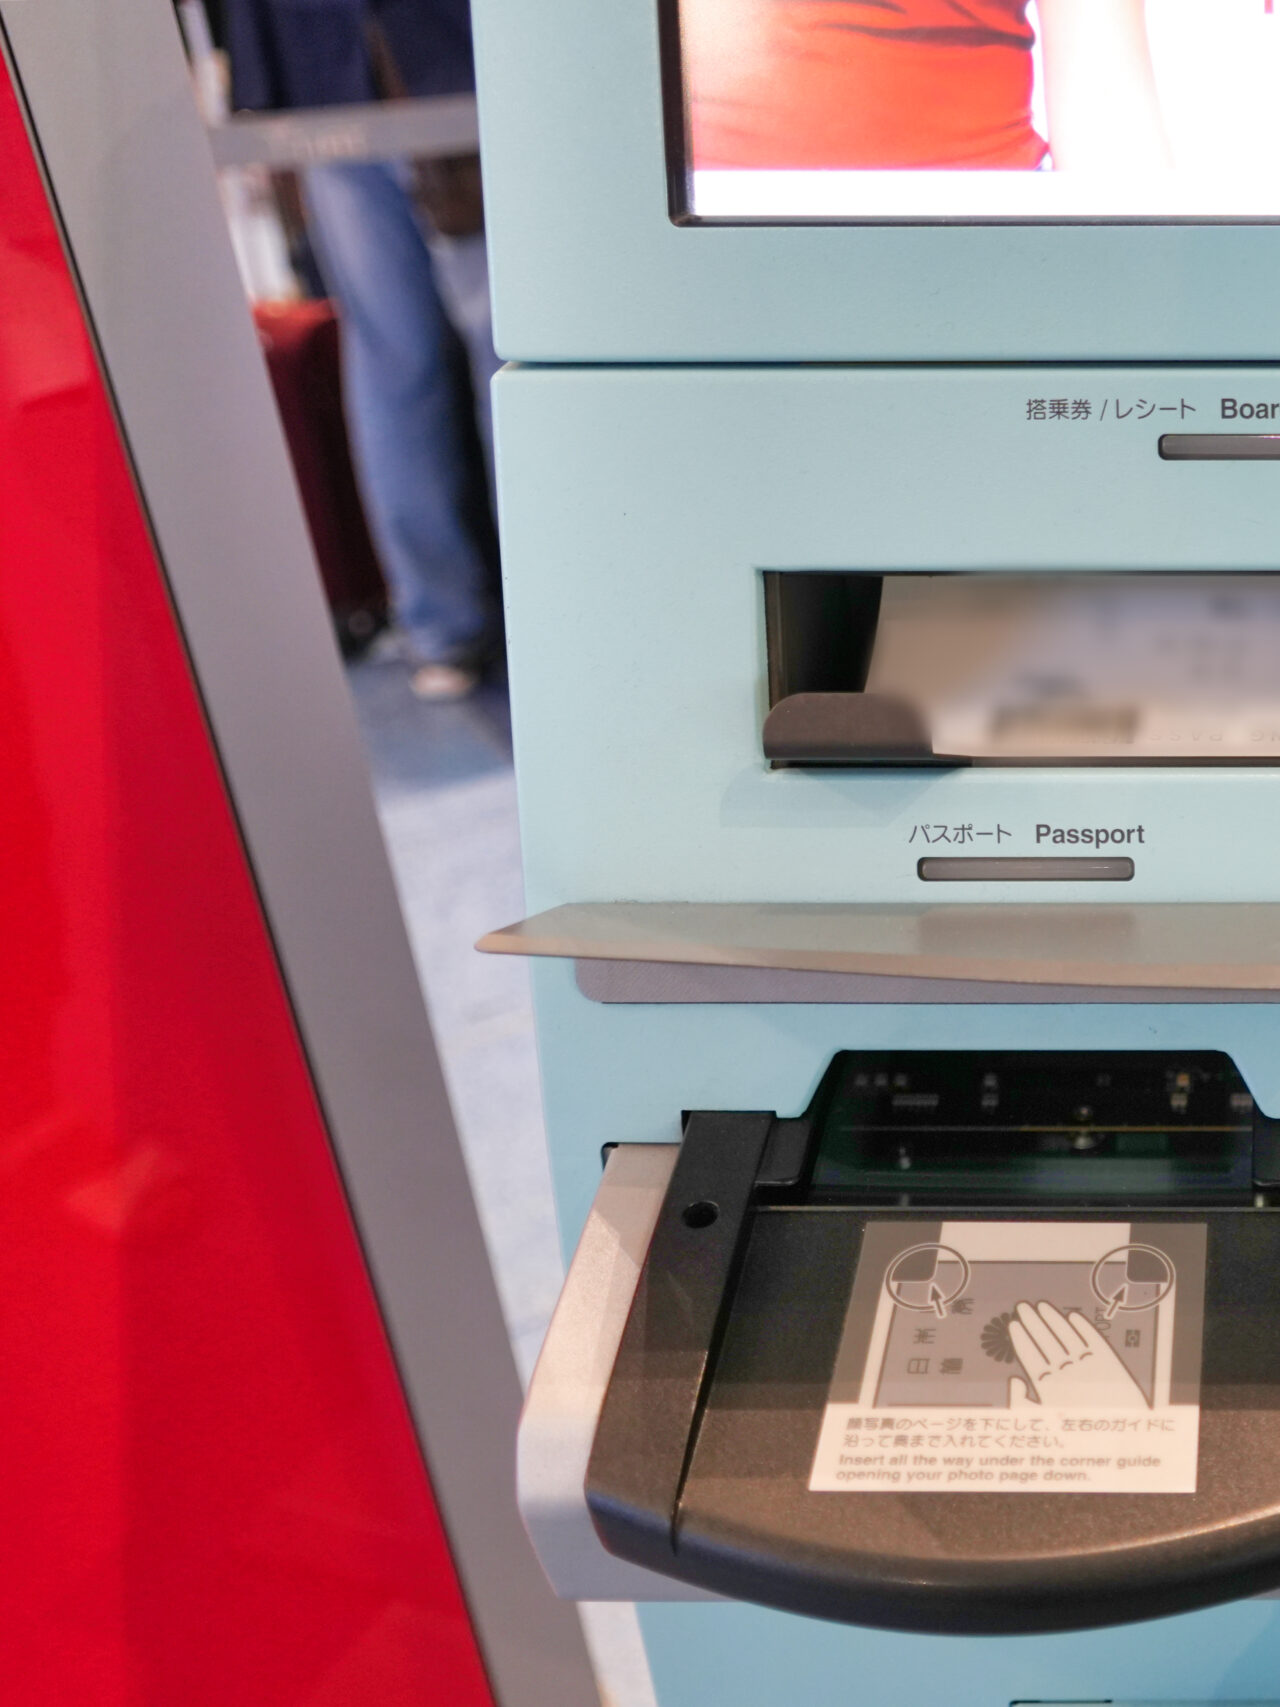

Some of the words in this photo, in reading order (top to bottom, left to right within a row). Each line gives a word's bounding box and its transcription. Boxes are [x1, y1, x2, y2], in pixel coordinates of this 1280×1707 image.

[1026, 398, 1092, 421] 搭乗券
[1115, 398, 1197, 420] レシート
[908, 823, 1013, 844] パスポート
[1035, 823, 1145, 849] Passport
[838, 1455, 885, 1467] Insert
[889, 1455, 908, 1467] all
[912, 1455, 938, 1467] the
[942, 1458, 974, 1470] way
[979, 1455, 1025, 1467] under
[1030, 1455, 1055, 1467] the
[1060, 1457, 1111, 1467] corner
[1117, 1456, 1161, 1470] guide
[836, 1470, 901, 1483] opening
[907, 1472, 943, 1483] your
[947, 1469, 994, 1483] photo
[1000, 1472, 1039, 1484] page
[1043, 1470, 1091, 1482] down.
